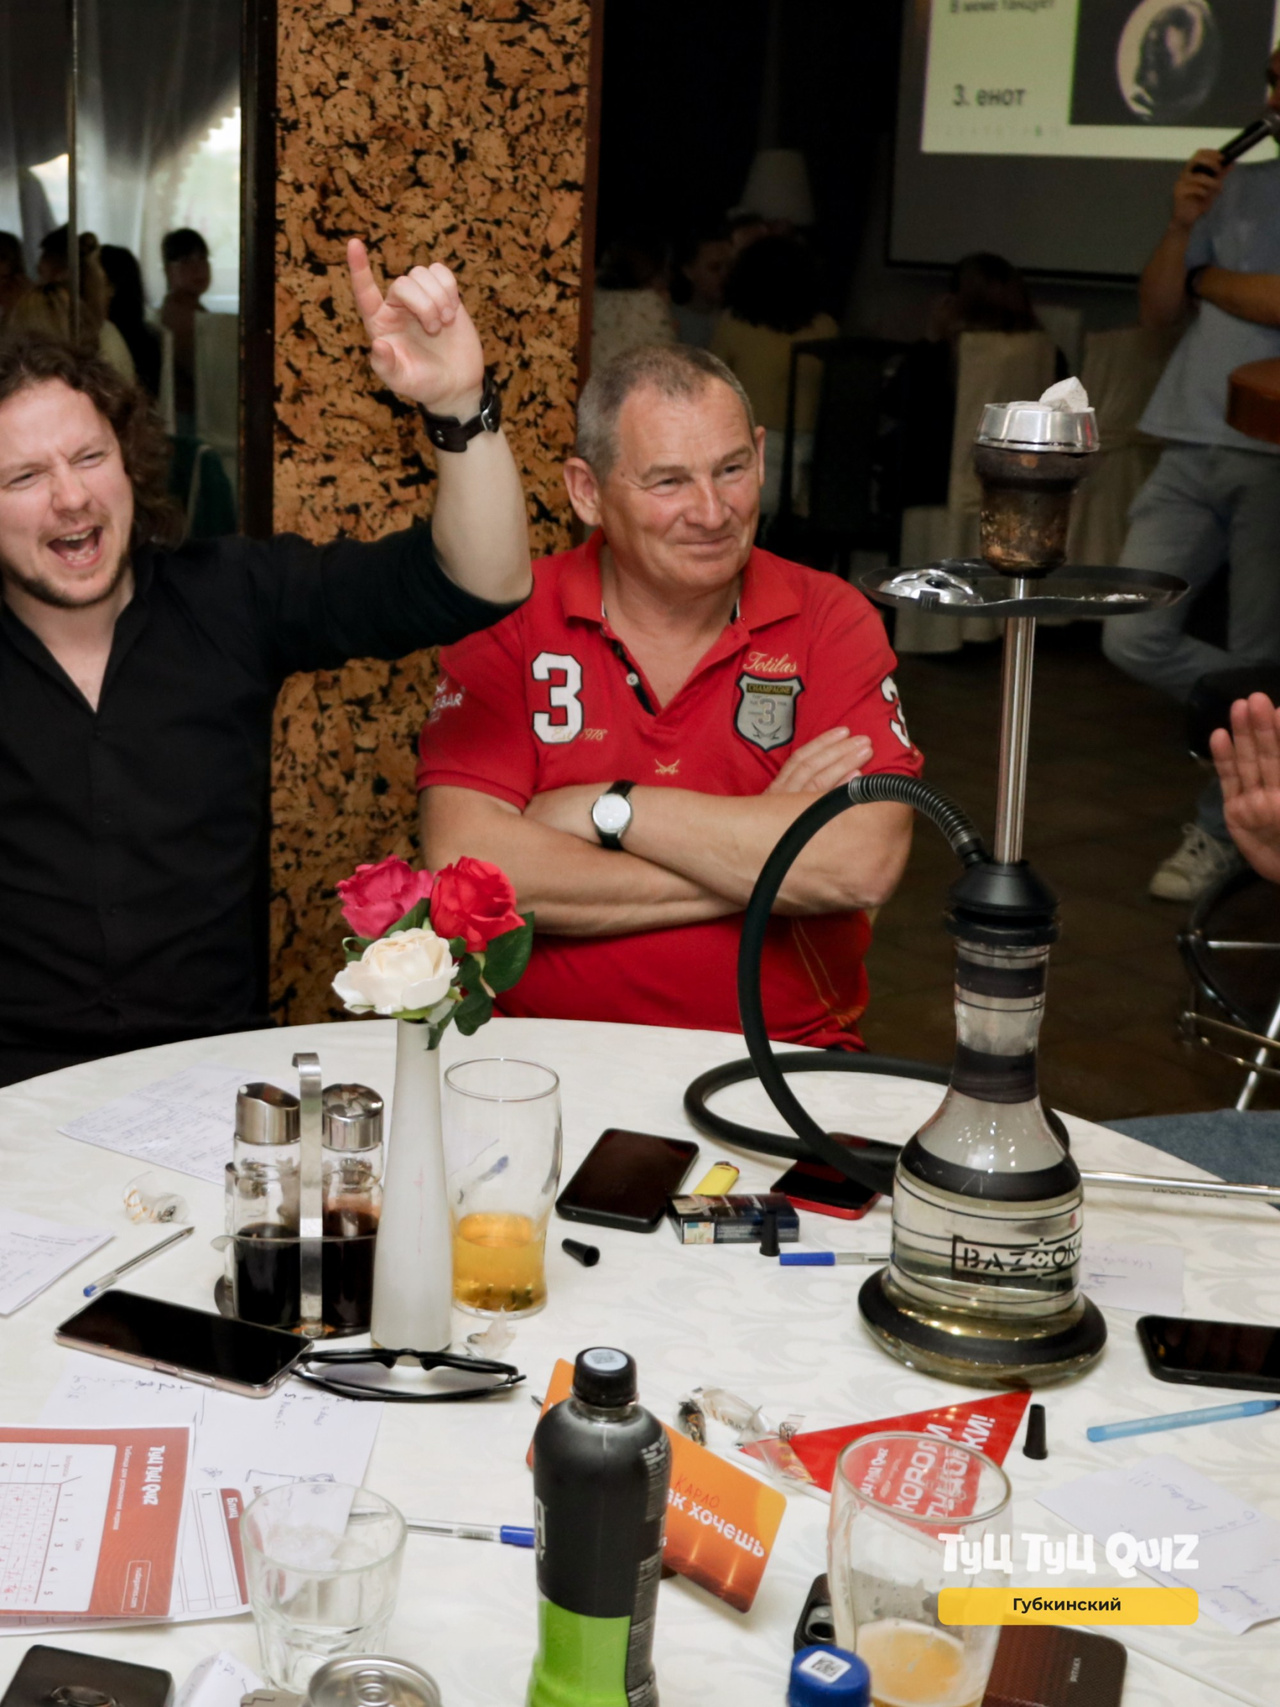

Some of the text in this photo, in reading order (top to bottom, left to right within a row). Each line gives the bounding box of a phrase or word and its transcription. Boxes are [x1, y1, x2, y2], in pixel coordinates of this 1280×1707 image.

[953, 84, 1026, 107] 3. енот
[742, 651, 797, 673] Totilas
[531, 651, 584, 745] 3
[748, 684, 792, 696] CHAMPAGNE
[758, 698, 776, 726] 3
[892, 1423, 952, 1512] КОРОЛИ
[226, 1497, 239, 1519] Блиц
[687, 1501, 766, 1558] хочешь
